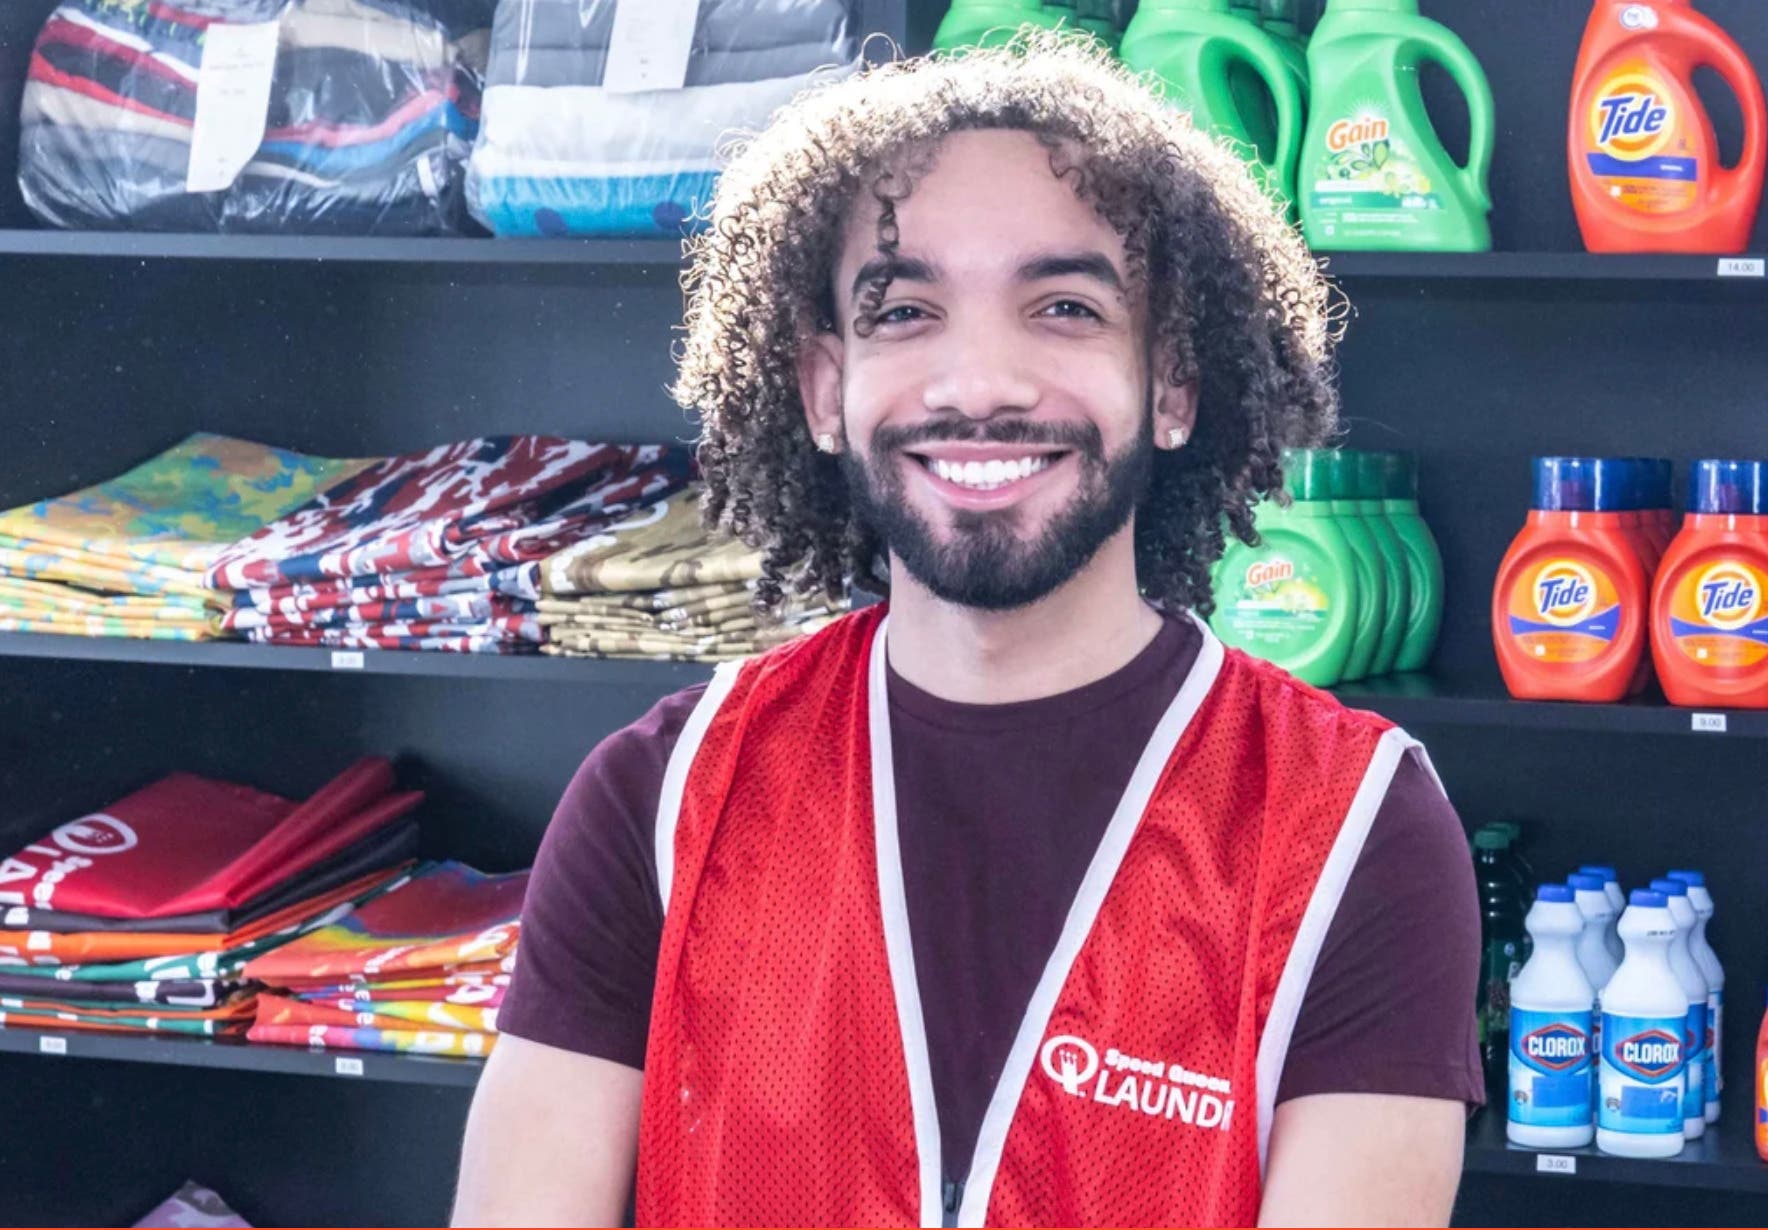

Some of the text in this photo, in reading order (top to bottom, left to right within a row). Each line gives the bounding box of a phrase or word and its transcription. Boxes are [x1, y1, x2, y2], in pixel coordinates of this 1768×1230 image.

[1327, 117, 1388, 151] Gain
[1599, 95, 1667, 144] Tide
[1247, 560, 1293, 586] Gain
[1540, 578, 1589, 613] Tide
[1703, 581, 1754, 616] Tide
[1528, 1036, 1586, 1058] CLOROX
[1623, 1042, 1680, 1063] CLOROX
